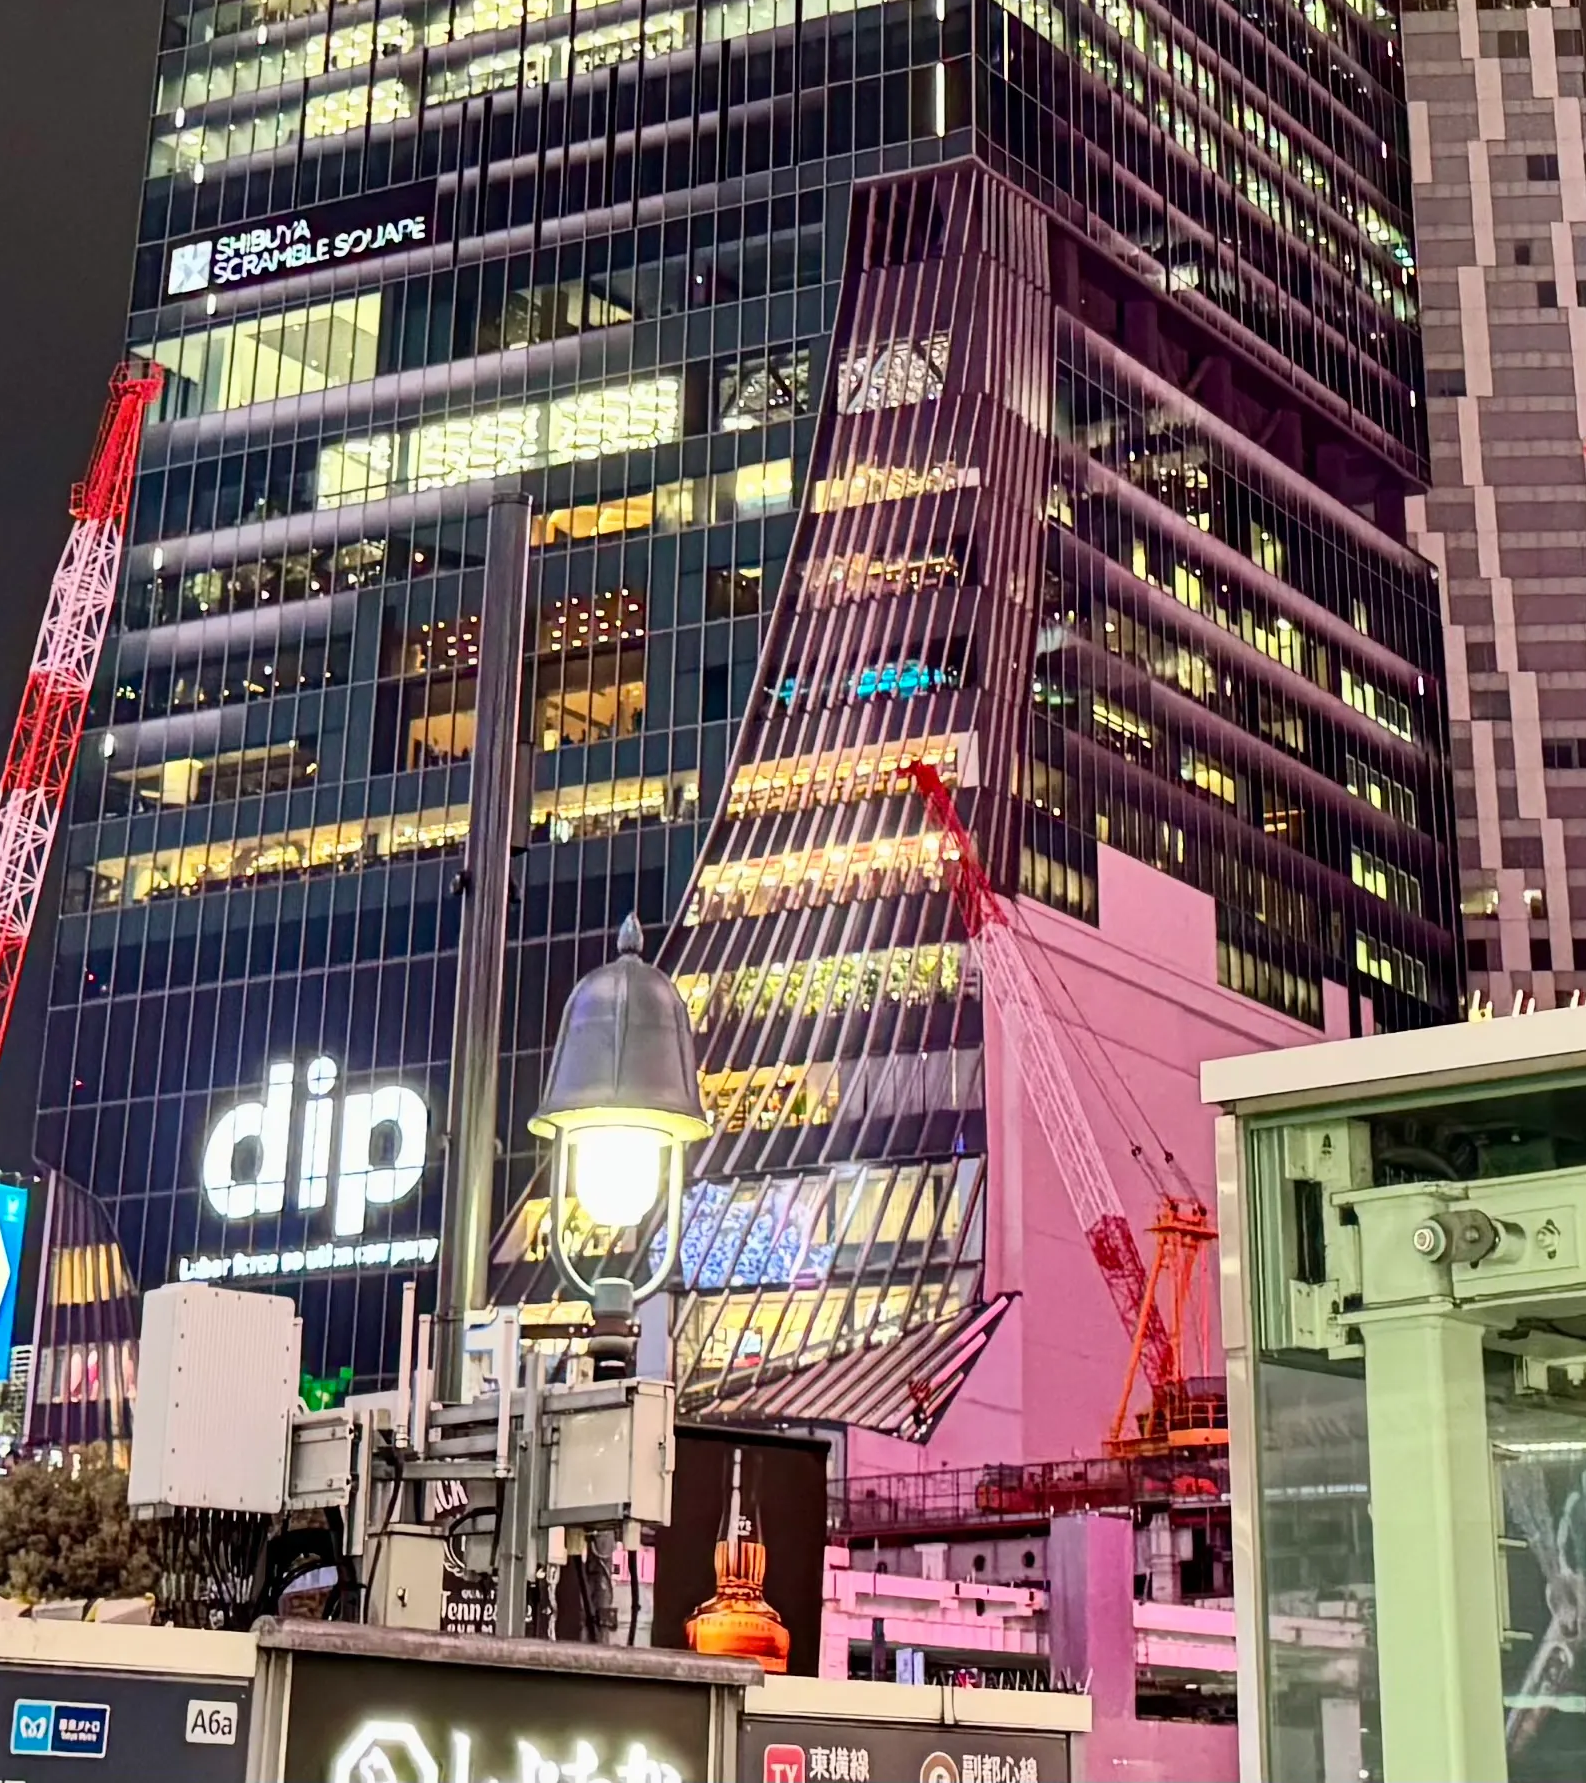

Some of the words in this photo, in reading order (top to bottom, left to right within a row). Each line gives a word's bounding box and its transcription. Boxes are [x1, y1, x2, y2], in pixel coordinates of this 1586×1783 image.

[213, 242, 330, 285] SCRAMBLE
[333, 216, 426, 254] SQUARE
[216, 219, 311, 261] SHIBUYA
[203, 1055, 429, 1237] dip
[191, 1708, 232, 1736] A6a
[809, 1746, 870, 1782] 東横線
